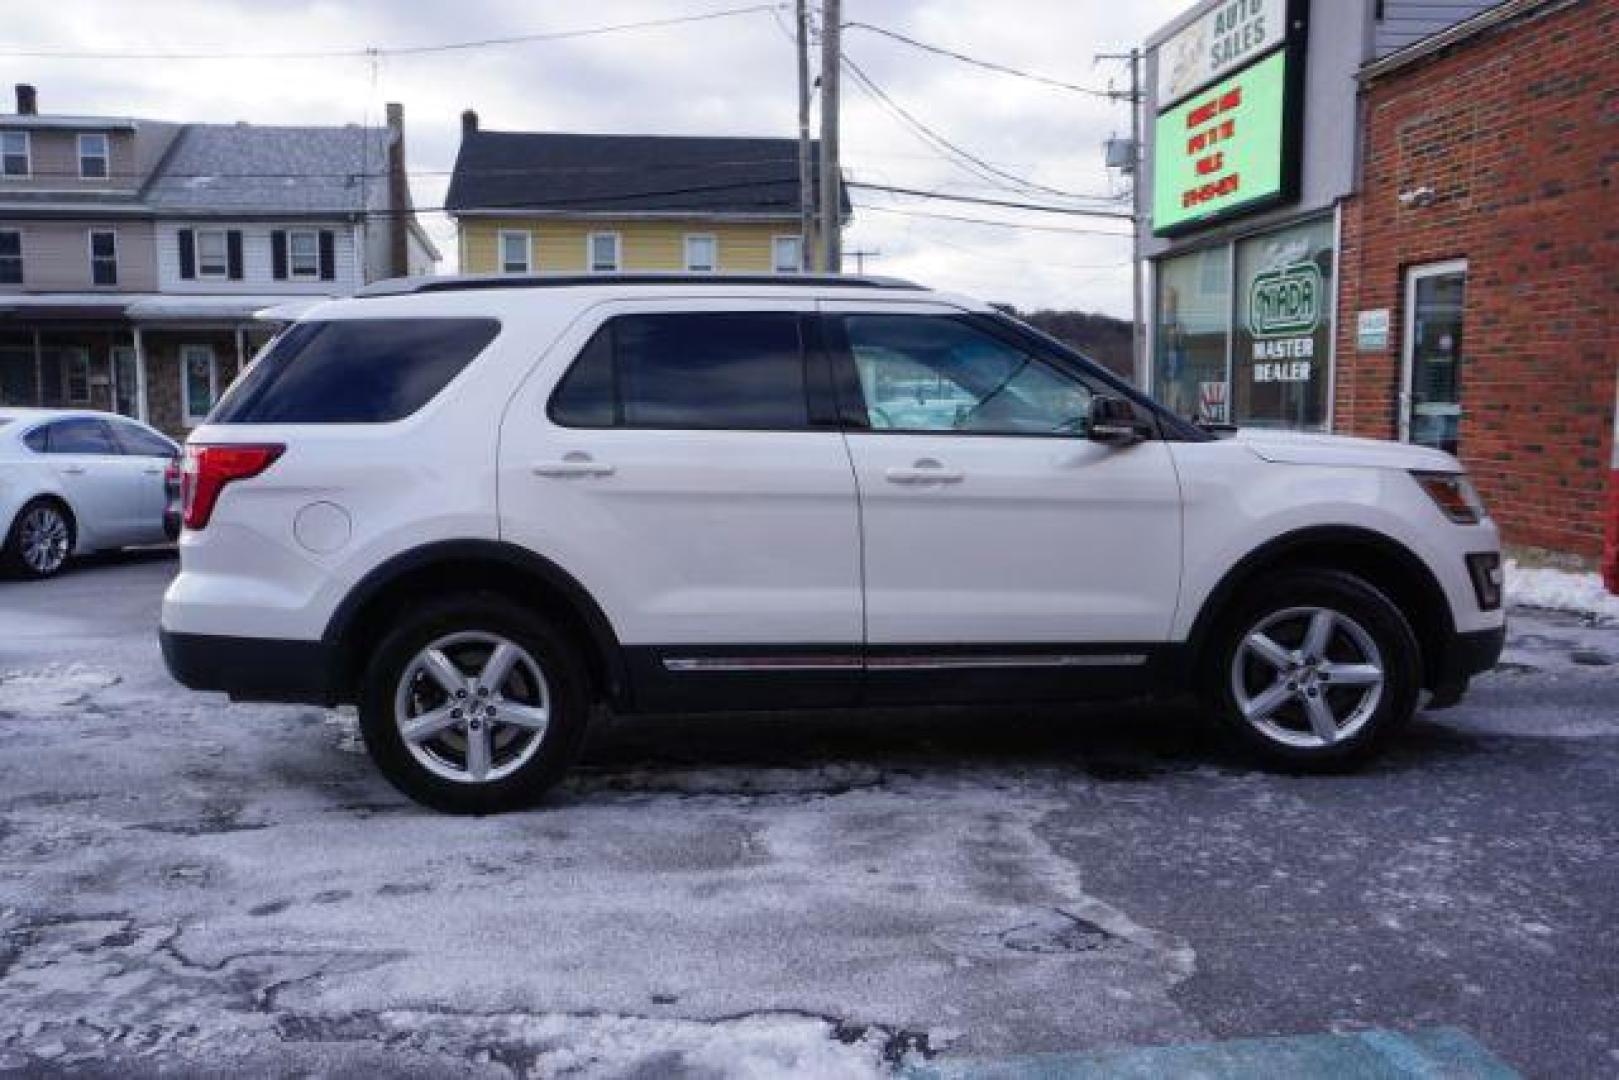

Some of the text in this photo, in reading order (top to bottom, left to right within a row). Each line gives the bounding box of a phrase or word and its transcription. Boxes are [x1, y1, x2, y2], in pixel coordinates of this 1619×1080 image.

[1214, 0, 1262, 38] AUTO
[1211, 15, 1265, 70] SALES
[1253, 338, 1314, 360] MASTER
[1254, 361, 1311, 382] DEALER
